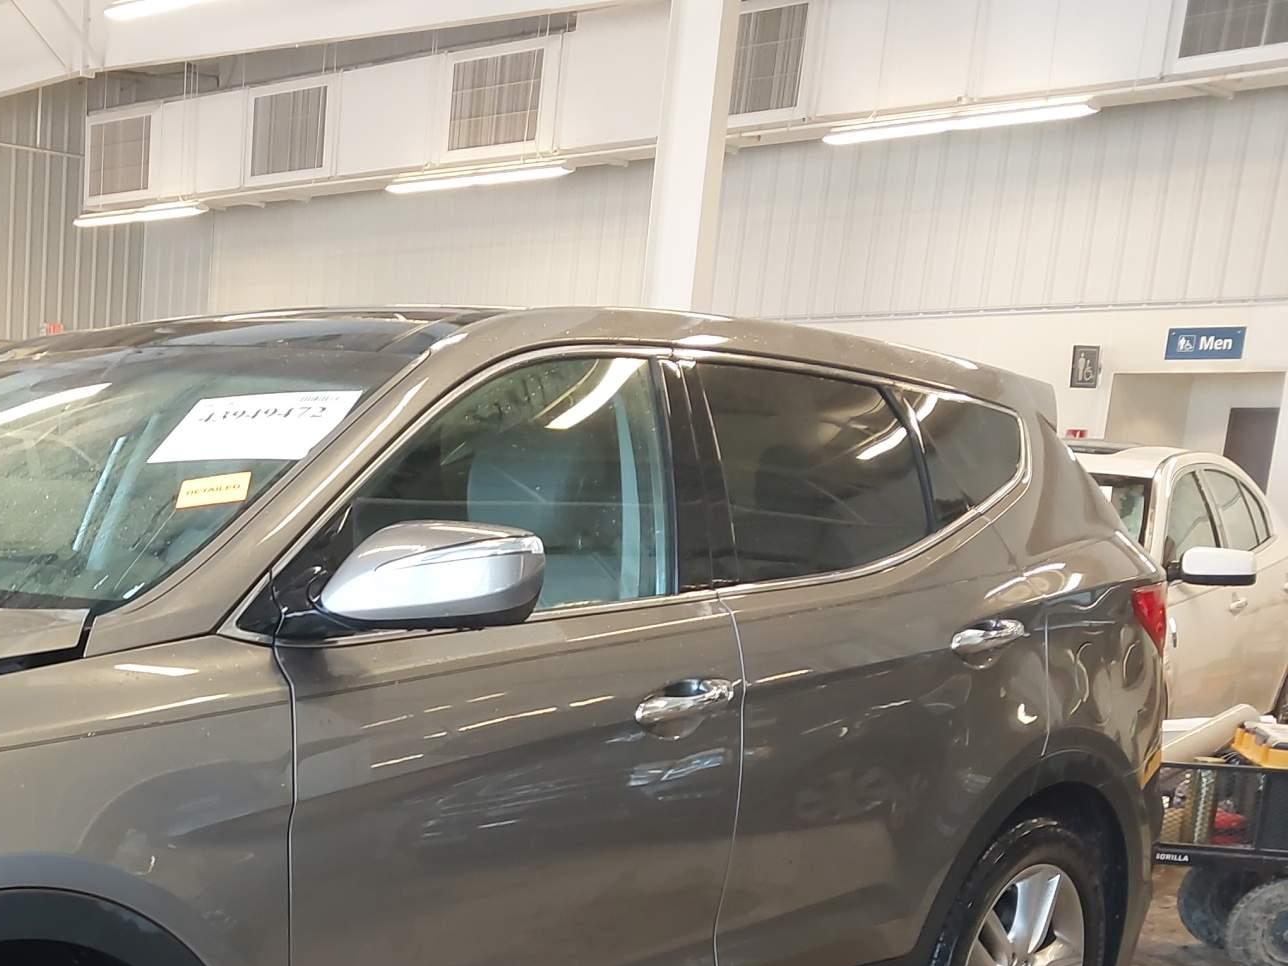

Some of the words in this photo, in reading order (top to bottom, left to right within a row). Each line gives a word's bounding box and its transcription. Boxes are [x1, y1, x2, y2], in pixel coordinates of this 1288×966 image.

[1199, 335, 1233, 350] Men
[198, 406, 327, 422] 43949472
[1155, 852, 1189, 862] GORILLA
